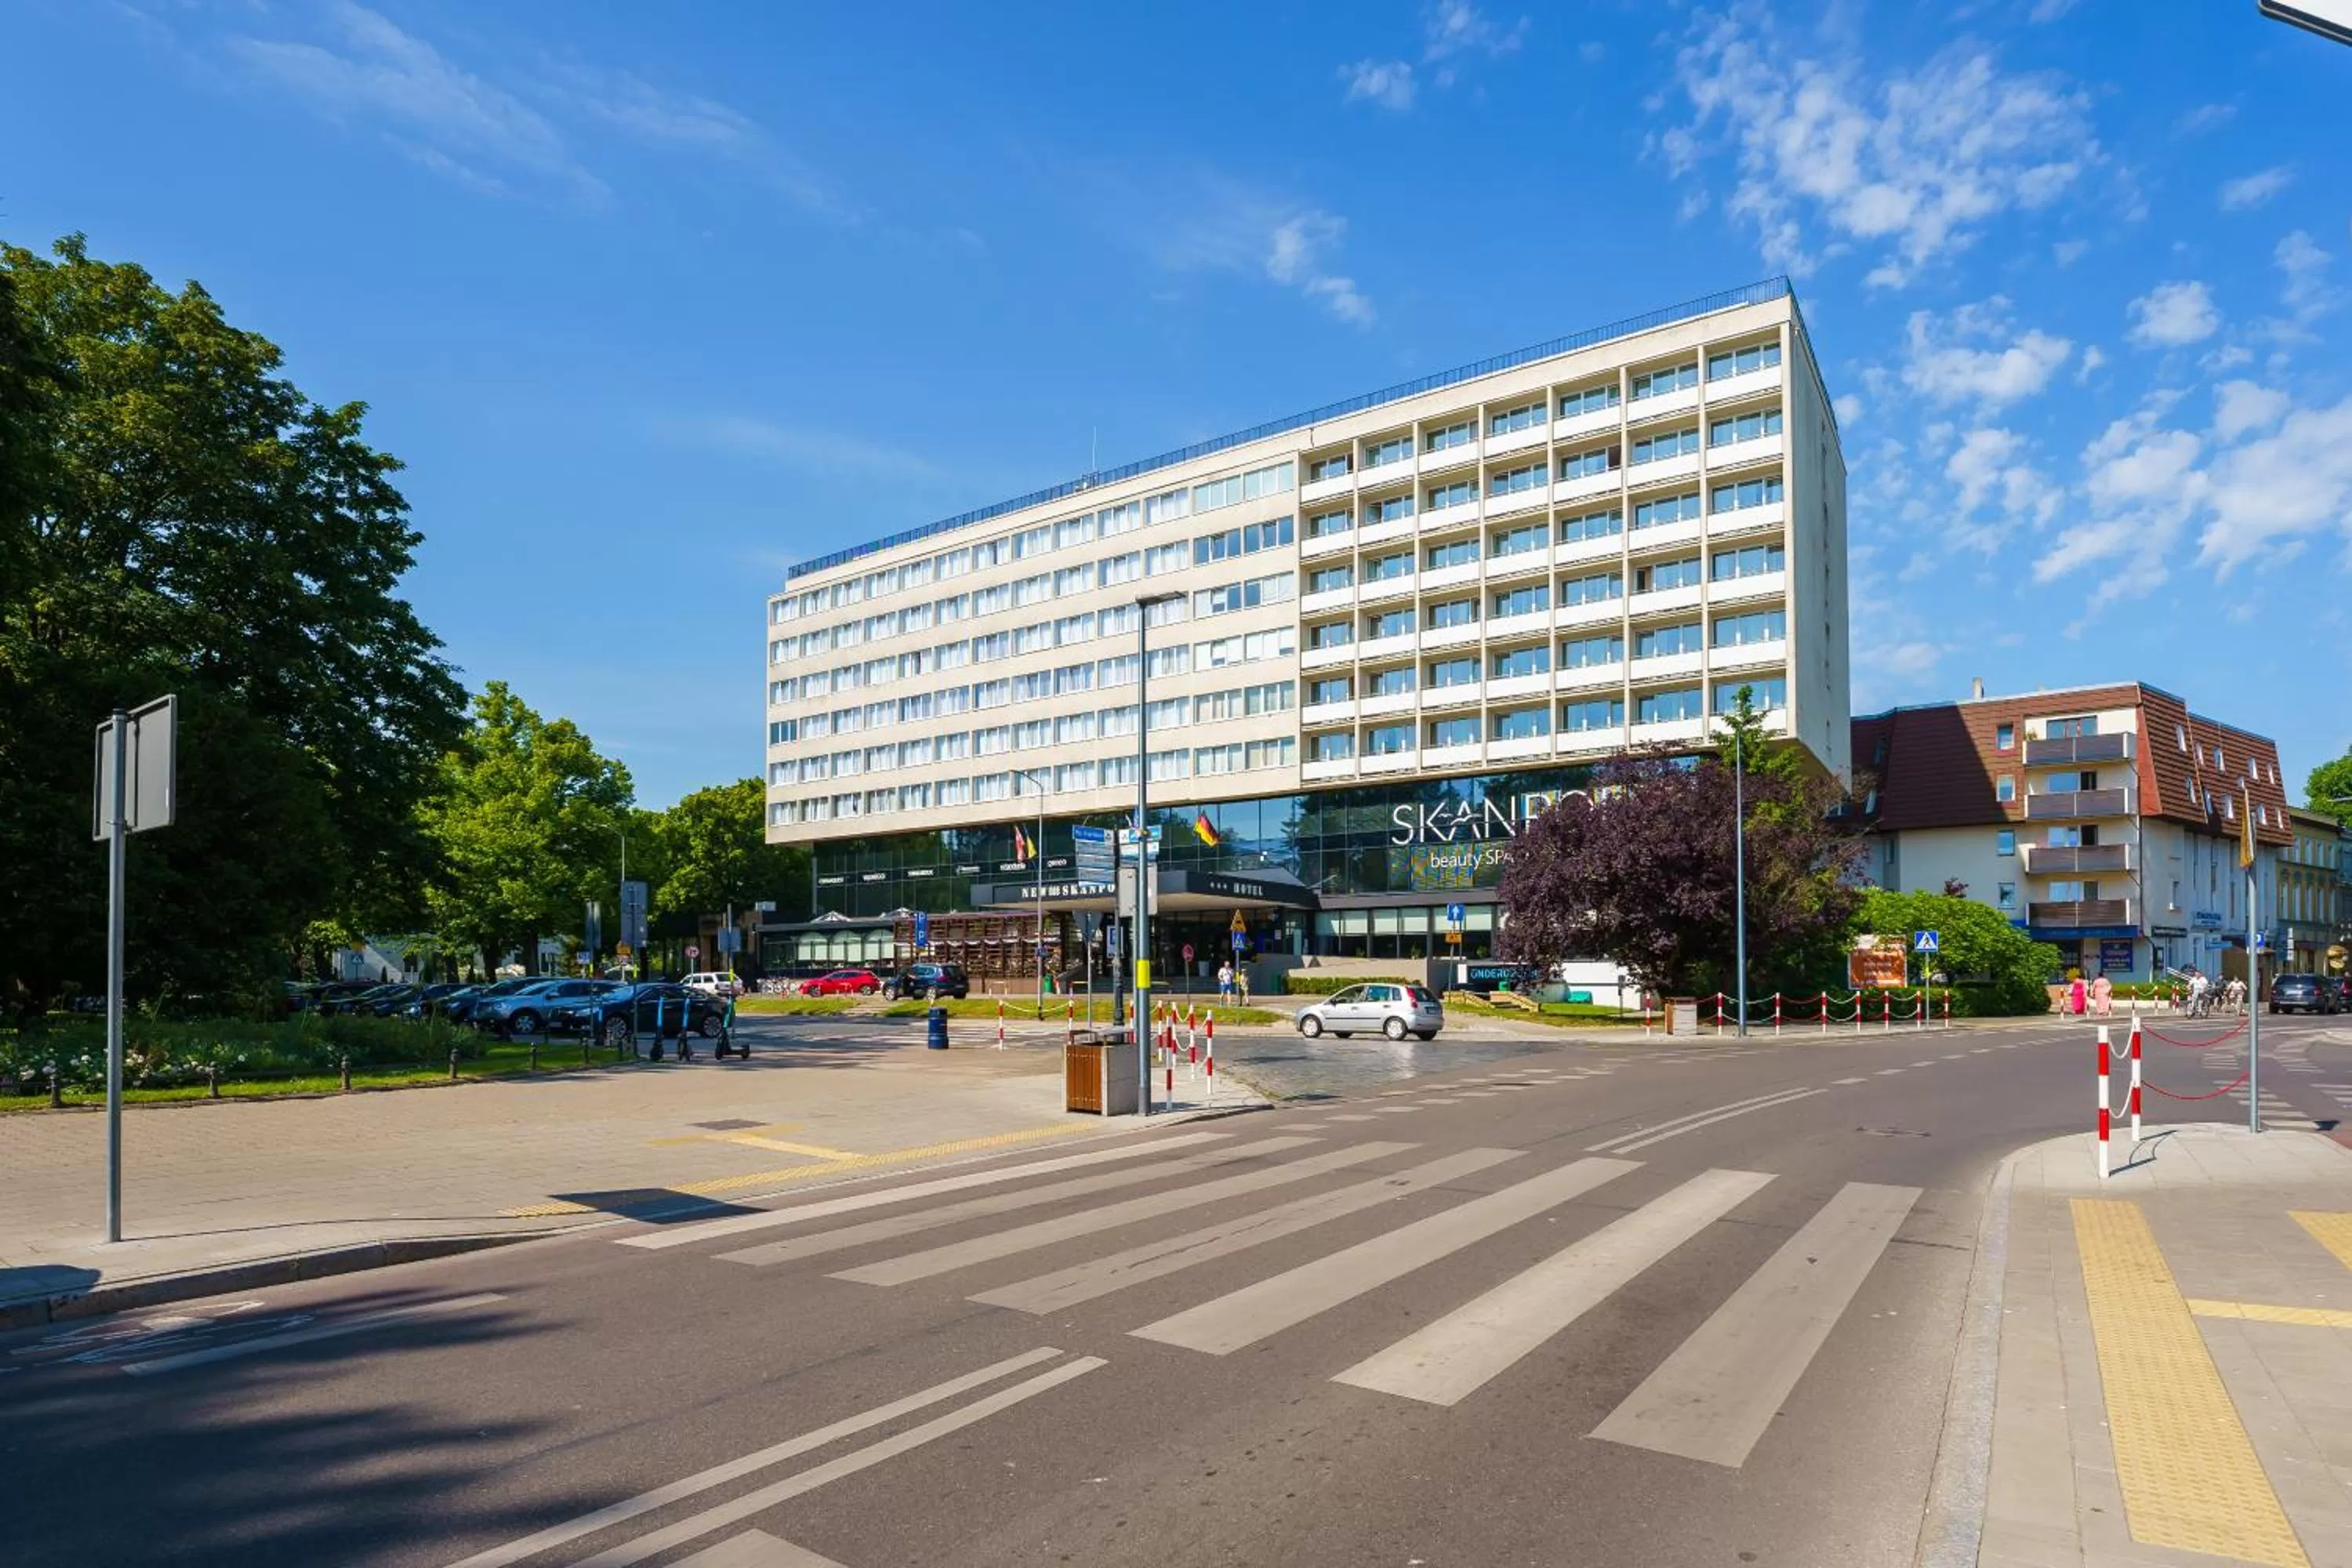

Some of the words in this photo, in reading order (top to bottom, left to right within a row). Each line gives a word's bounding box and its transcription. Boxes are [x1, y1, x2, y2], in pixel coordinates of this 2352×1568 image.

[1392, 789, 1595, 846] SKANP
[1430, 852, 1482, 869] beauty
[1486, 849, 1514, 865] SPA
[1022, 887, 1046, 898] NEW
[1062, 884, 1116, 895] SKANPO
[1233, 883, 1263, 896] HOTEL
[918, 913, 925, 923] P
[918, 931, 925, 940] P
